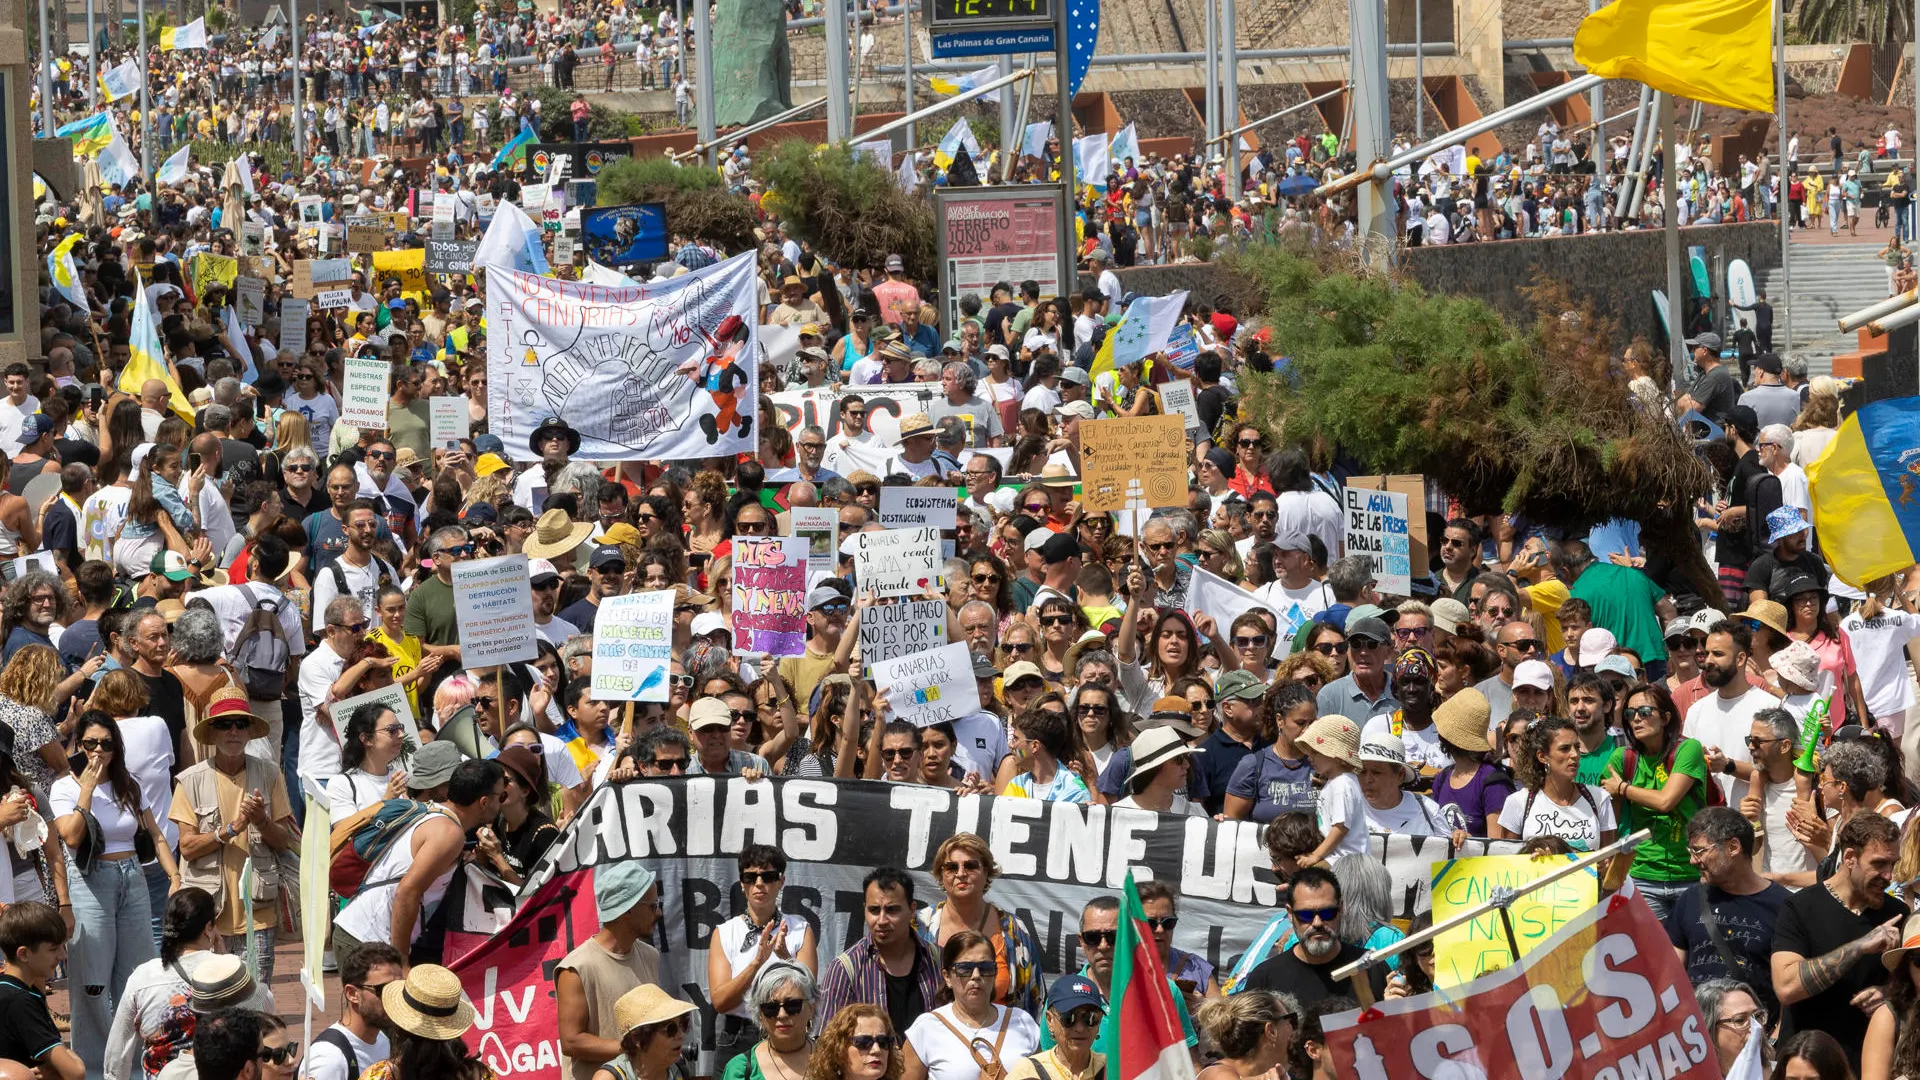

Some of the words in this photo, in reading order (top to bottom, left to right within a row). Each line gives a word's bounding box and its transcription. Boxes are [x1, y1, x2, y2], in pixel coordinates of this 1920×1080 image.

[937, 40, 952, 49] Las
[953, 38, 982, 48] Palmas
[983, 37, 995, 46] de
[995, 36, 1016, 45] Gran
[1017, 34, 1049, 43] Canaria
[947, 205, 980, 214] AVANCE
[948, 217, 1010, 231] FEBRERO
[950, 228, 991, 243] JUNIO
[430, 241, 459, 252] TODOS
[462, 244, 476, 253] MIS
[949, 240, 983, 254] 2024
[434, 252, 469, 260] VECINOS
[429, 260, 444, 269] SON
[513, 270, 541, 297] NO
[574, 284, 652, 304] VENDE
[323, 291, 344, 301] PELIGRO
[522, 298, 637, 326] CANARIAS
[673, 325, 690, 345] NO
[345, 360, 388, 369] DEFENDEMOS
[350, 372, 383, 380] NUESTRAS
[350, 384, 381, 392] ESPECIES
[541, 373, 569, 407] NO
[351, 396, 378, 404] PORQUE
[344, 407, 384, 417] VALORAMOS
[341, 419, 371, 427] NUESTRA
[642, 407, 668, 433] STOP
[1104, 419, 1154, 438] territorio
[1095, 439, 1124, 452] pueblo
[905, 496, 957, 509] ECOSISTEMAS
[1347, 490, 1364, 511] EL
[1366, 494, 1394, 514] AGUA
[881, 512, 927, 524] DESTRUCCIÓN
[1351, 511, 1365, 530] DE
[1367, 513, 1382, 532] LAS
[912, 527, 938, 543] NO
[1347, 532, 1370, 552] PARA
[902, 545, 936, 558] vende
[458, 570, 489, 580] PÉRDIDA
[499, 564, 523, 574] SUELO
[1371, 556, 1383, 574] MI
[459, 580, 489, 590] COLAPSO
[500, 575, 526, 584] PAISAJE
[861, 576, 910, 598] defiende
[468, 587, 518, 600] DESTRUCCIÓN
[736, 585, 753, 614] Y
[493, 613, 529, 624] TRANSICIÓN
[651, 611, 668, 625] DE
[861, 607, 878, 625] LO
[882, 603, 909, 624] QUE
[913, 600, 943, 619] HAGO
[468, 627, 506, 637] ENERGÉTICA
[507, 623, 526, 632] JUSTA
[860, 626, 880, 645] NO
[883, 625, 898, 645] ES
[903, 622, 929, 642] POR
[467, 641, 481, 649] con
[481, 638, 492, 647] las
[493, 635, 524, 647] personas
[477, 648, 486, 656] la
[486, 643, 522, 655] naturaleza
[597, 639, 626, 658] MÁS
[861, 645, 877, 664] MÍ
[883, 644, 898, 660] ES
[622, 660, 639, 672] DE
[889, 653, 946, 680] CANARIAS
[596, 675, 634, 692] AVES
[891, 681, 904, 693] NO
[925, 669, 953, 686] VENDE
[1535, 810, 1592, 835] Salvar
[890, 785, 1159, 889] TIENE
[1543, 822, 1596, 840] Aaete
[1445, 870, 1580, 906] CANARIAS
[1469, 906, 1516, 942] NO
[1409, 932, 1681, 1080] SO.S.
